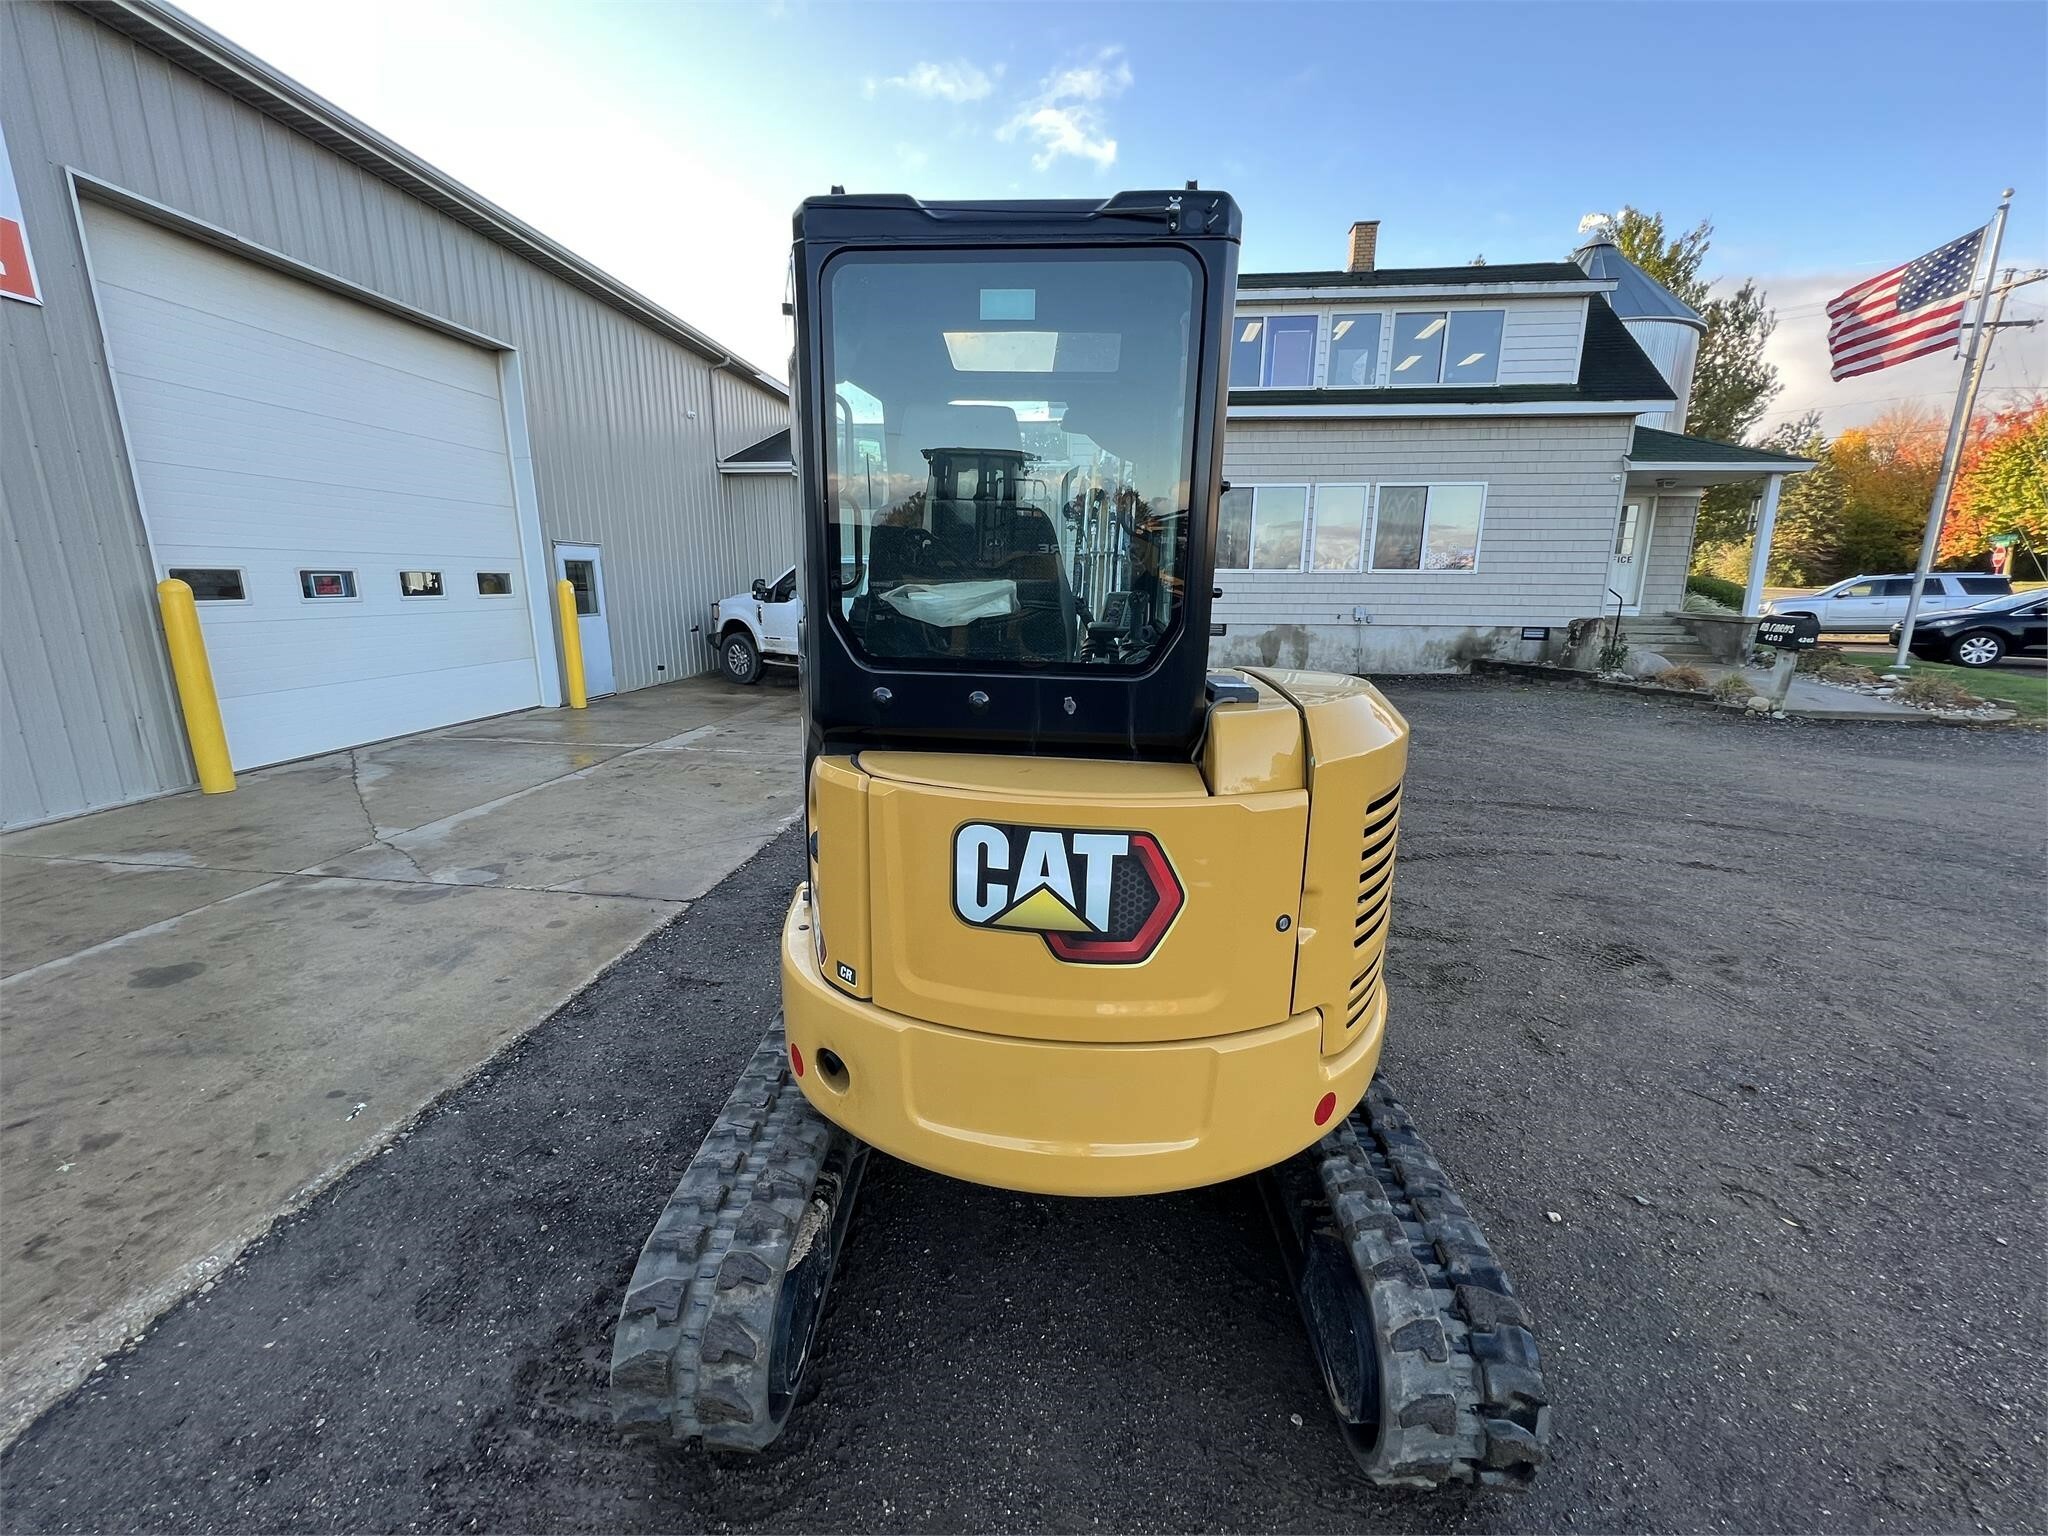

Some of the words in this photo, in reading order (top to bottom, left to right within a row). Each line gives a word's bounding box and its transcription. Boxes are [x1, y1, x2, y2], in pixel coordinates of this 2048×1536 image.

[1764, 634, 1783, 642] 4203
[956, 824, 1129, 932] CAT
[840, 966, 853, 981] CR
